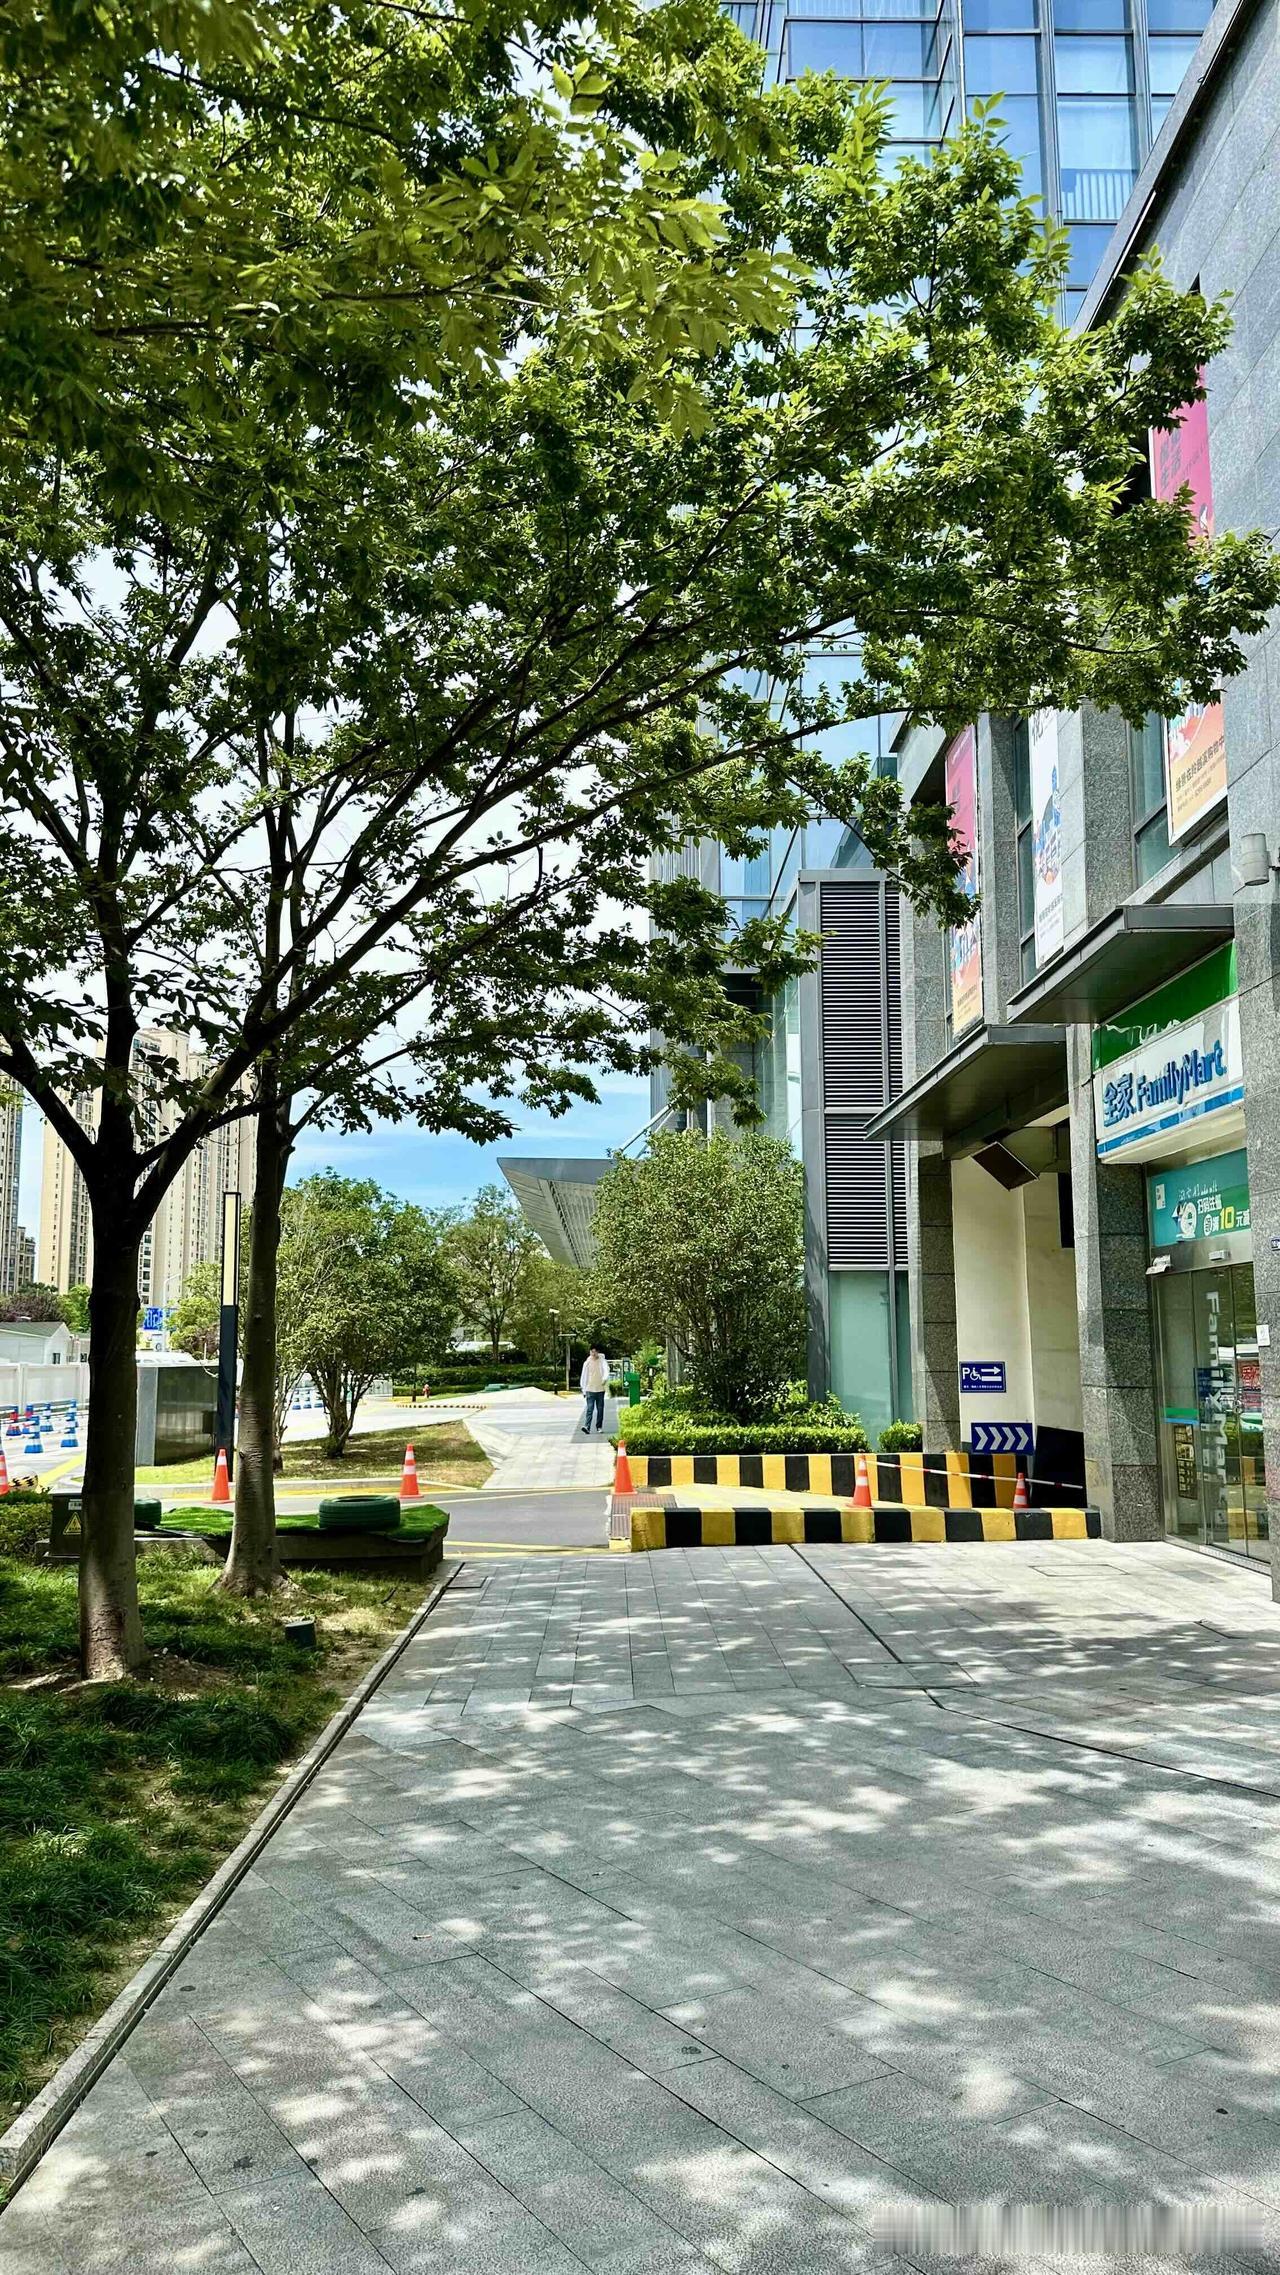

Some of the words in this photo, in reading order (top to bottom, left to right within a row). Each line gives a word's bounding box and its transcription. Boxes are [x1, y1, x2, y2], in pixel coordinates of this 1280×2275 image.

[1103, 1071, 1136, 1127] 全家
[1137, 1039, 1227, 1111] FamilyMart
[962, 1367, 970, 1380] P
[1206, 1291, 1228, 1500] FamilyMart
